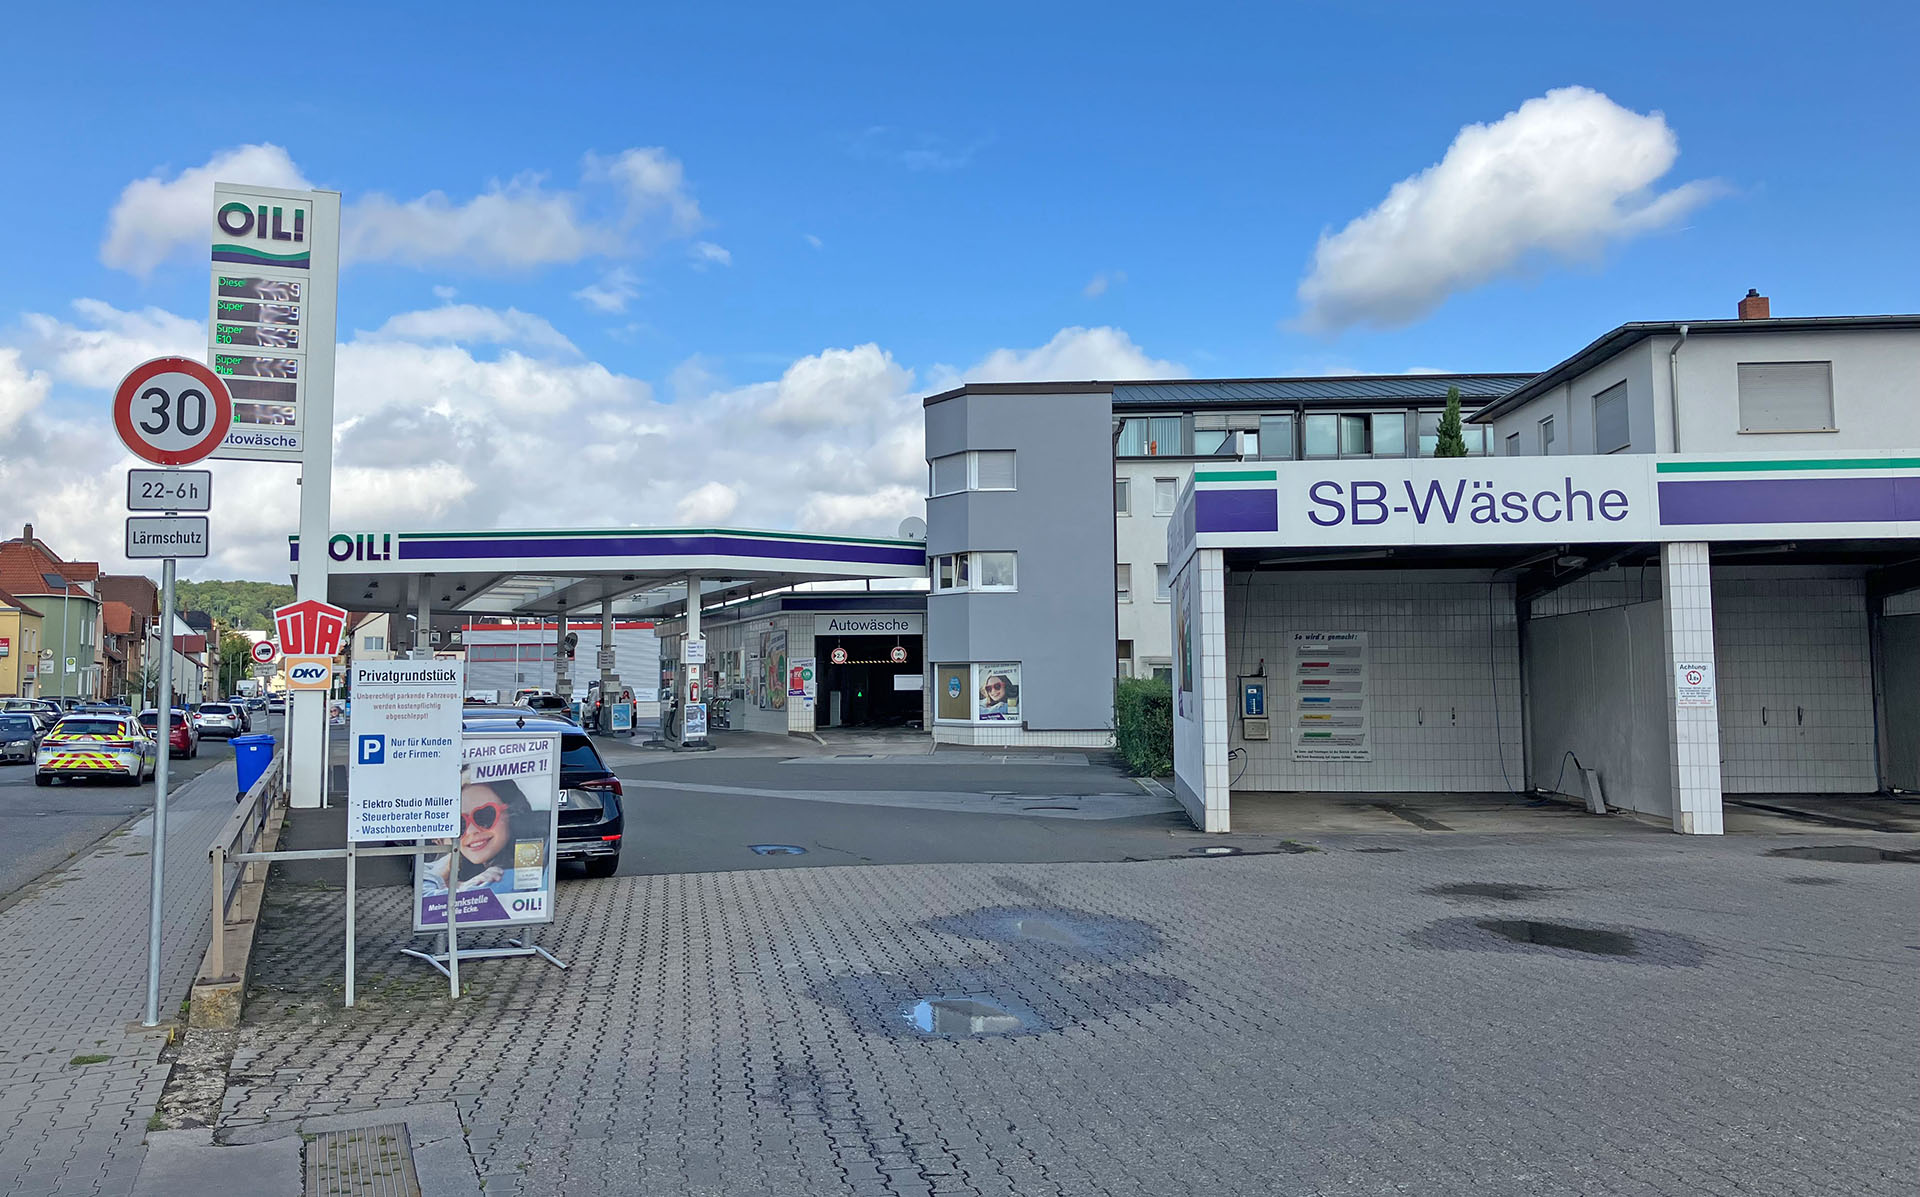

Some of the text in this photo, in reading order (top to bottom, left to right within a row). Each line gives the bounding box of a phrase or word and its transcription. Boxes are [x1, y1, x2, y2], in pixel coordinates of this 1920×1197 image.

[217, 201, 304, 242] OIL!
[218, 301, 244, 311] Super
[217, 324, 243, 334] Super
[216, 335, 232, 344] E10
[216, 354, 242, 365] Super
[215, 365, 233, 375] Plus
[139, 387, 207, 436] 30
[224, 433, 297, 447] towäsche
[1307, 477, 1629, 527] SB-Wäsche
[133, 531, 201, 544] Lärmschutz
[328, 534, 391, 561] OIL!
[276, 600, 346, 655] UTA
[828, 618, 909, 631] Autowäsche
[292, 668, 326, 678] DKV
[358, 669, 456, 683] Privatgrundstück
[357, 692, 396, 700] Unberechtigt
[426, 692, 458, 700] Fahrzeuge
[397, 702, 441, 710] kostenpflichtig
[391, 737, 452, 747] Nur für Kunden
[363, 739, 381, 760] P
[393, 750, 441, 759] der Firmen:
[469, 747, 496, 758] FAHR
[499, 744, 526, 755] GERN
[528, 740, 549, 751] ZUR
[476, 759, 548, 779] NUMMER 1!
[362, 800, 393, 809] Elektro
[395, 798, 422, 807] Studio
[424, 797, 453, 807] Müller
[362, 811, 422, 822] Steuerberater
[424, 810, 450, 819] Roser
[361, 823, 454, 835] Waschboxenbenutzer
[428, 894, 488, 912] Meine ankstelle
[512, 898, 542, 912] OIL!
[463, 906, 479, 914] Ecke.
